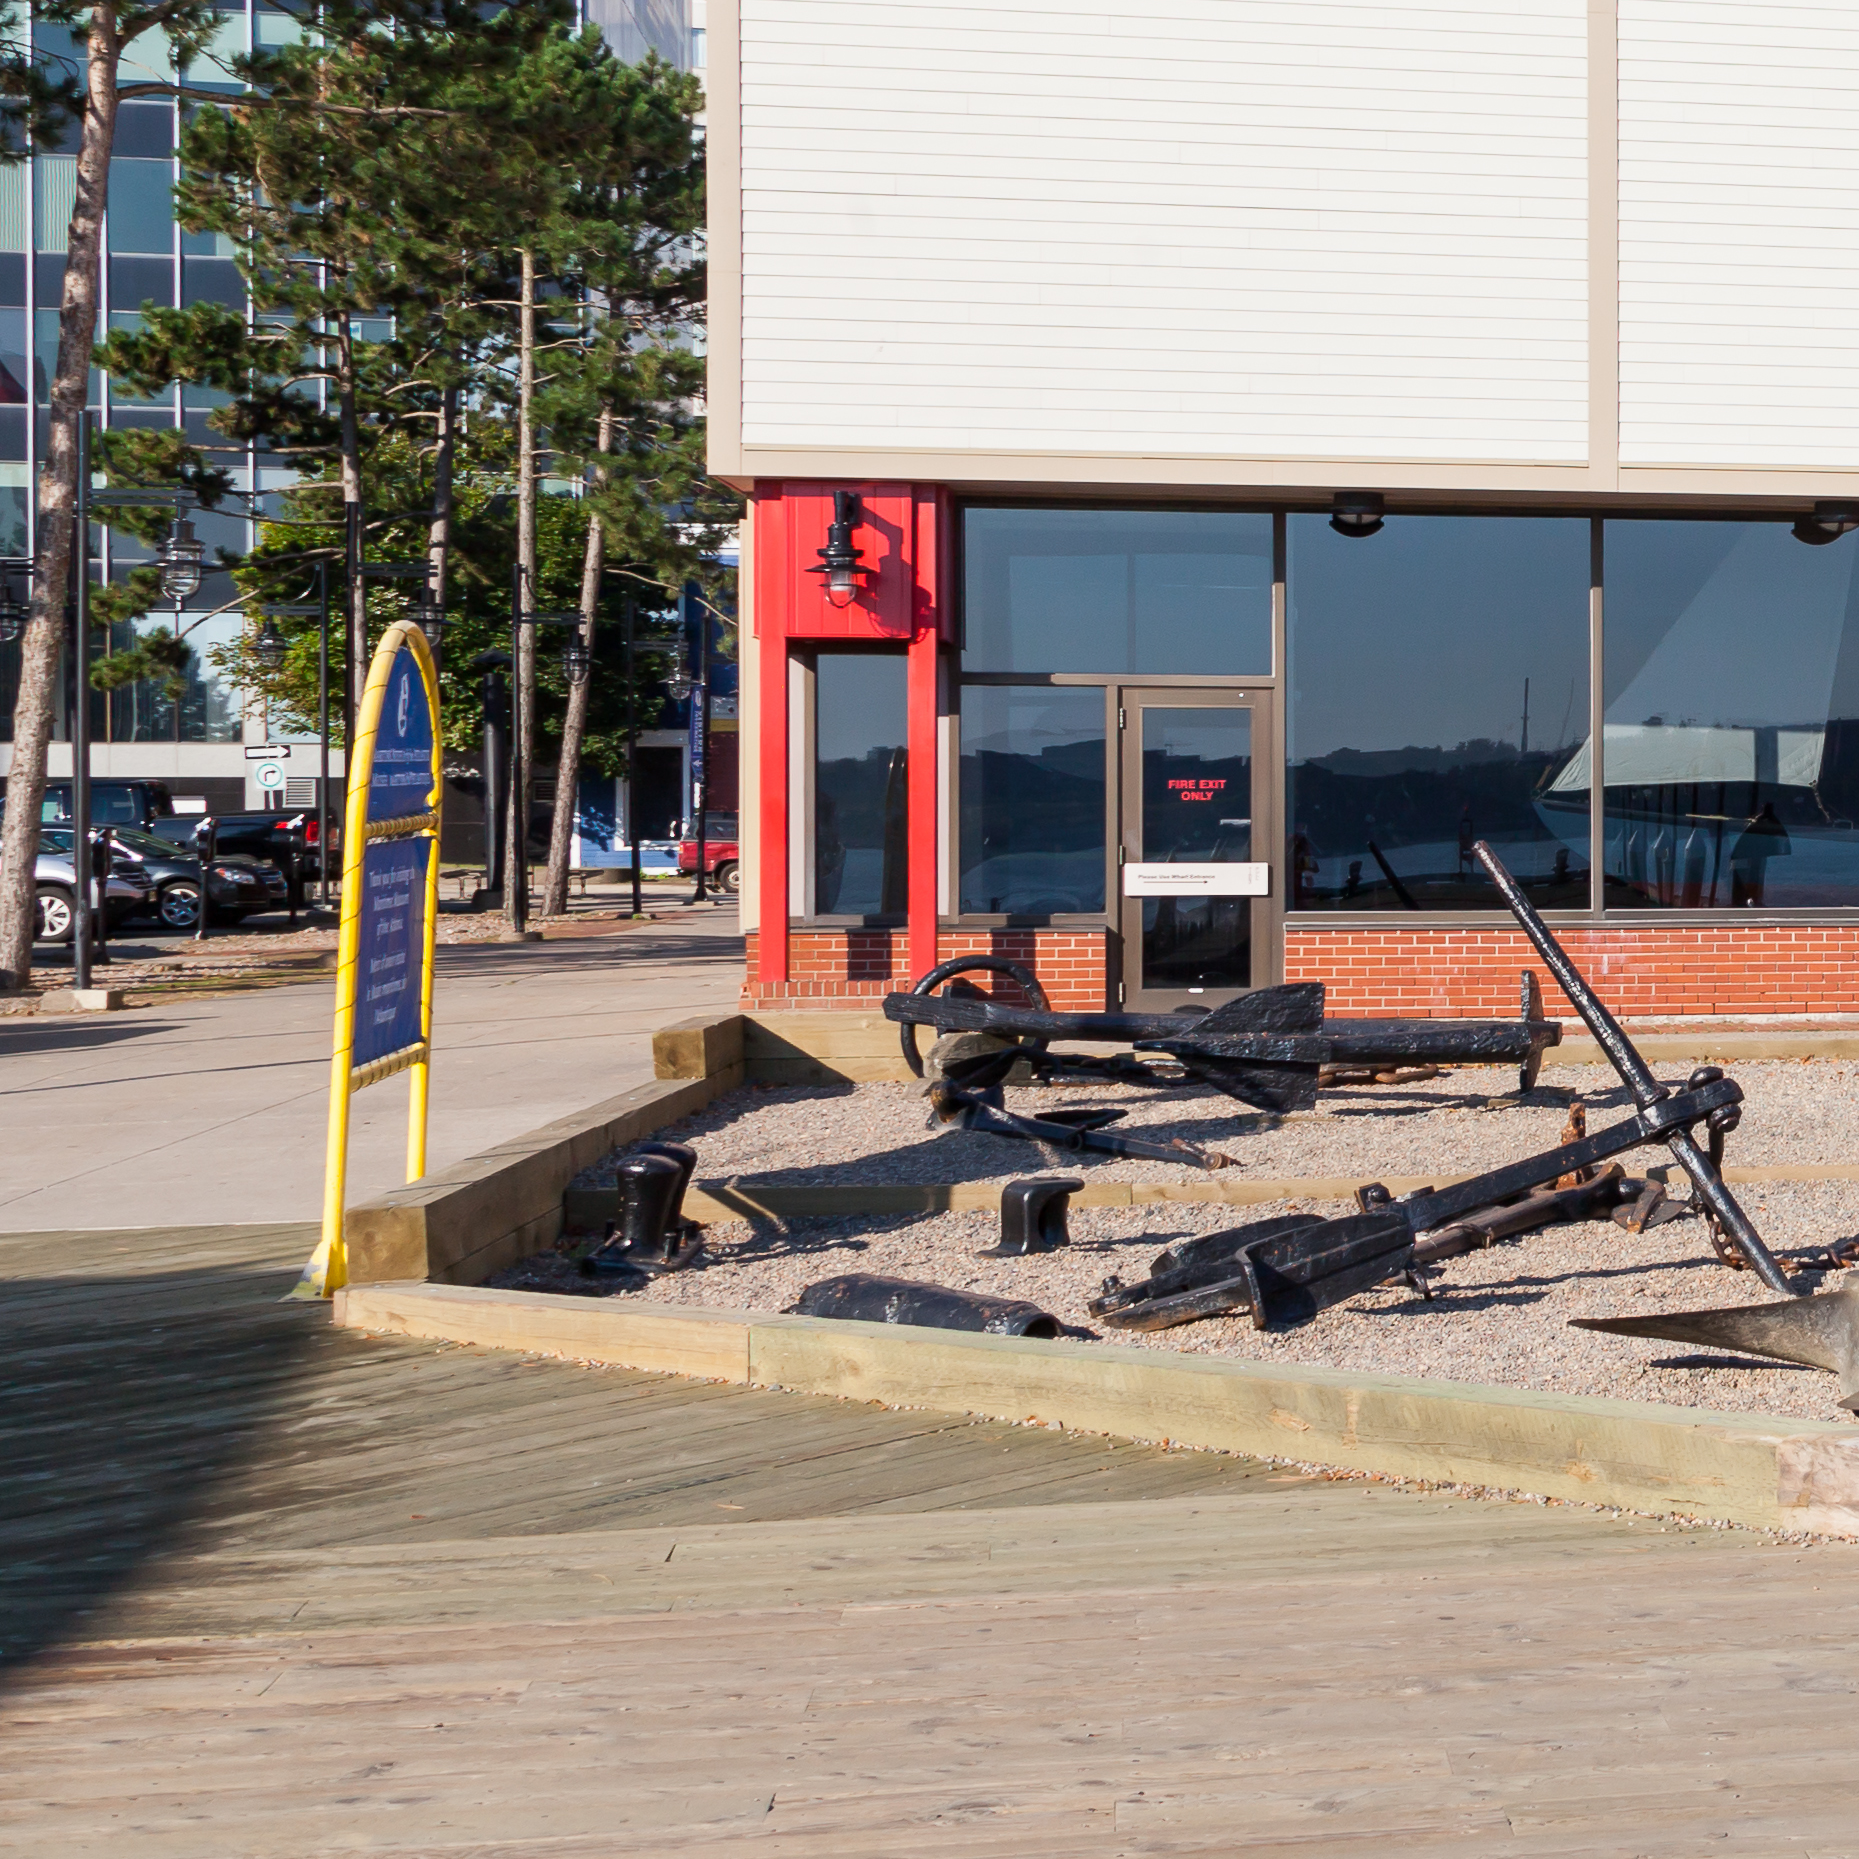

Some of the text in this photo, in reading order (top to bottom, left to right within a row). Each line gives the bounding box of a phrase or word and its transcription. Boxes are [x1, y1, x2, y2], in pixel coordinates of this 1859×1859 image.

[1168, 779, 1226, 789] FIRE EXIT
[1181, 791, 1213, 801] ONLY
